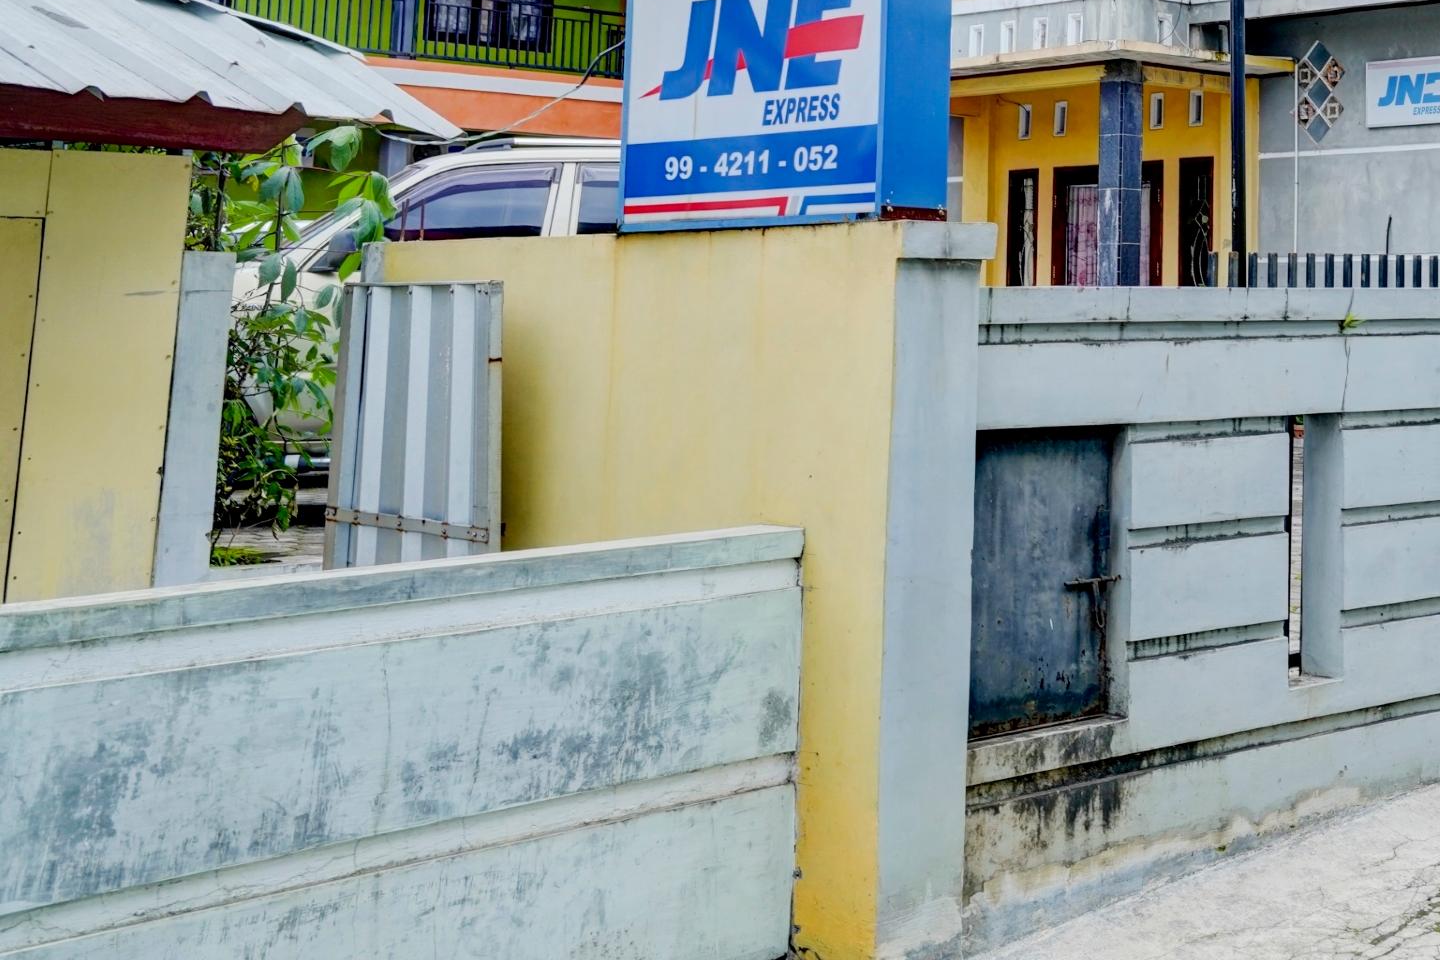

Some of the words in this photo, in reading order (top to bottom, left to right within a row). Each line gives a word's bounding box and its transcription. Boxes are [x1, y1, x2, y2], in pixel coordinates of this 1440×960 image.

[762, 93, 841, 126] EXPRESS
[1413, 105, 1440, 116] EXPRESS
[664, 155, 693, 181] 99
[714, 149, 770, 177] 4211
[793, 144, 839, 172] 052
